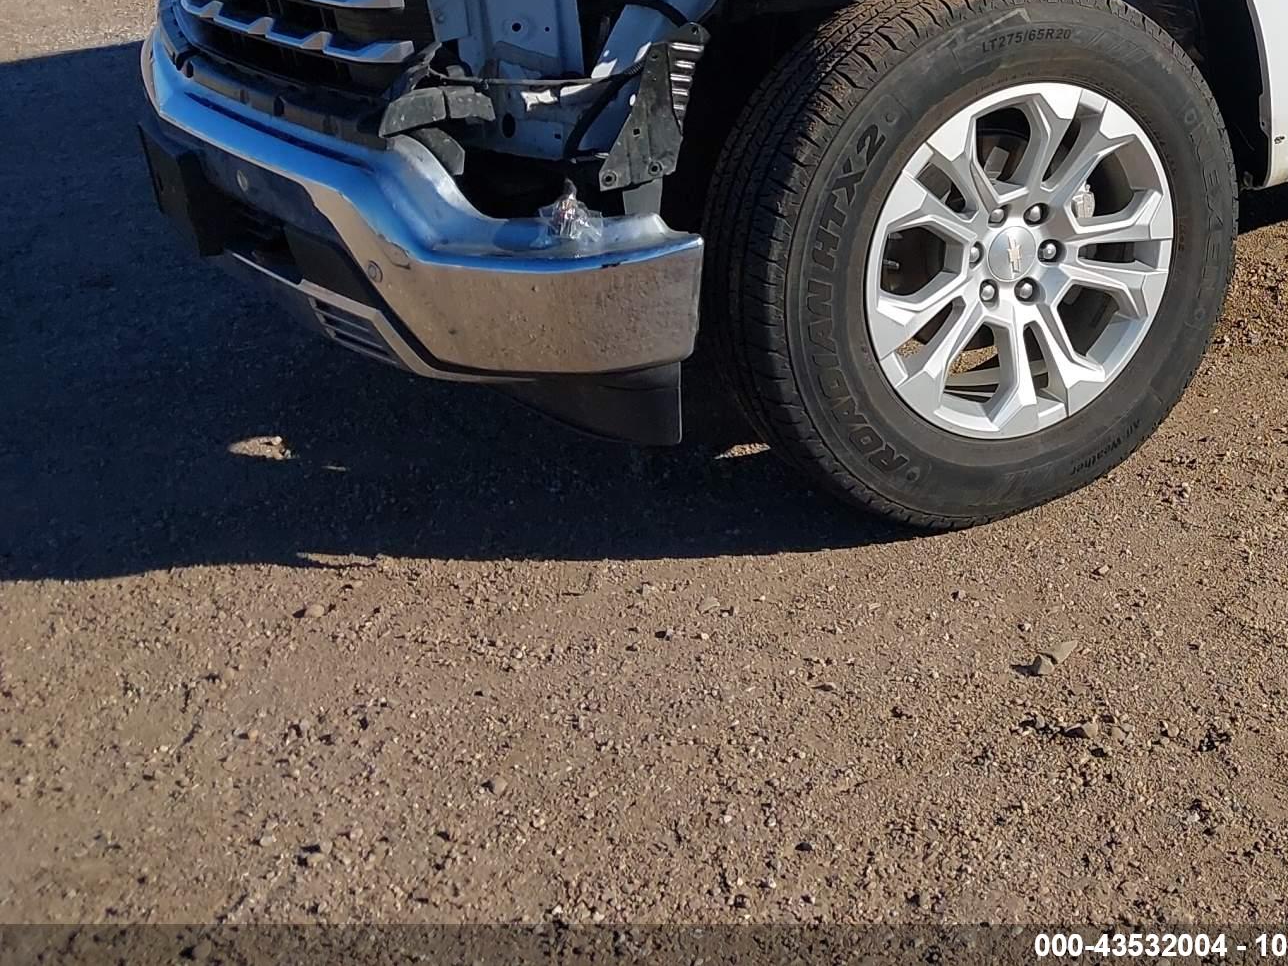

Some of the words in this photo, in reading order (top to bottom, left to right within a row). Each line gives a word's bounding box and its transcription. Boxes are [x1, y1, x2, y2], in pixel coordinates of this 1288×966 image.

[981, 28, 1073, 54] LT275/65R20
[807, 120, 887, 270] HTX2
[1186, 126, 1224, 298] NEXEN
[802, 280, 912, 475] ROADIAN
